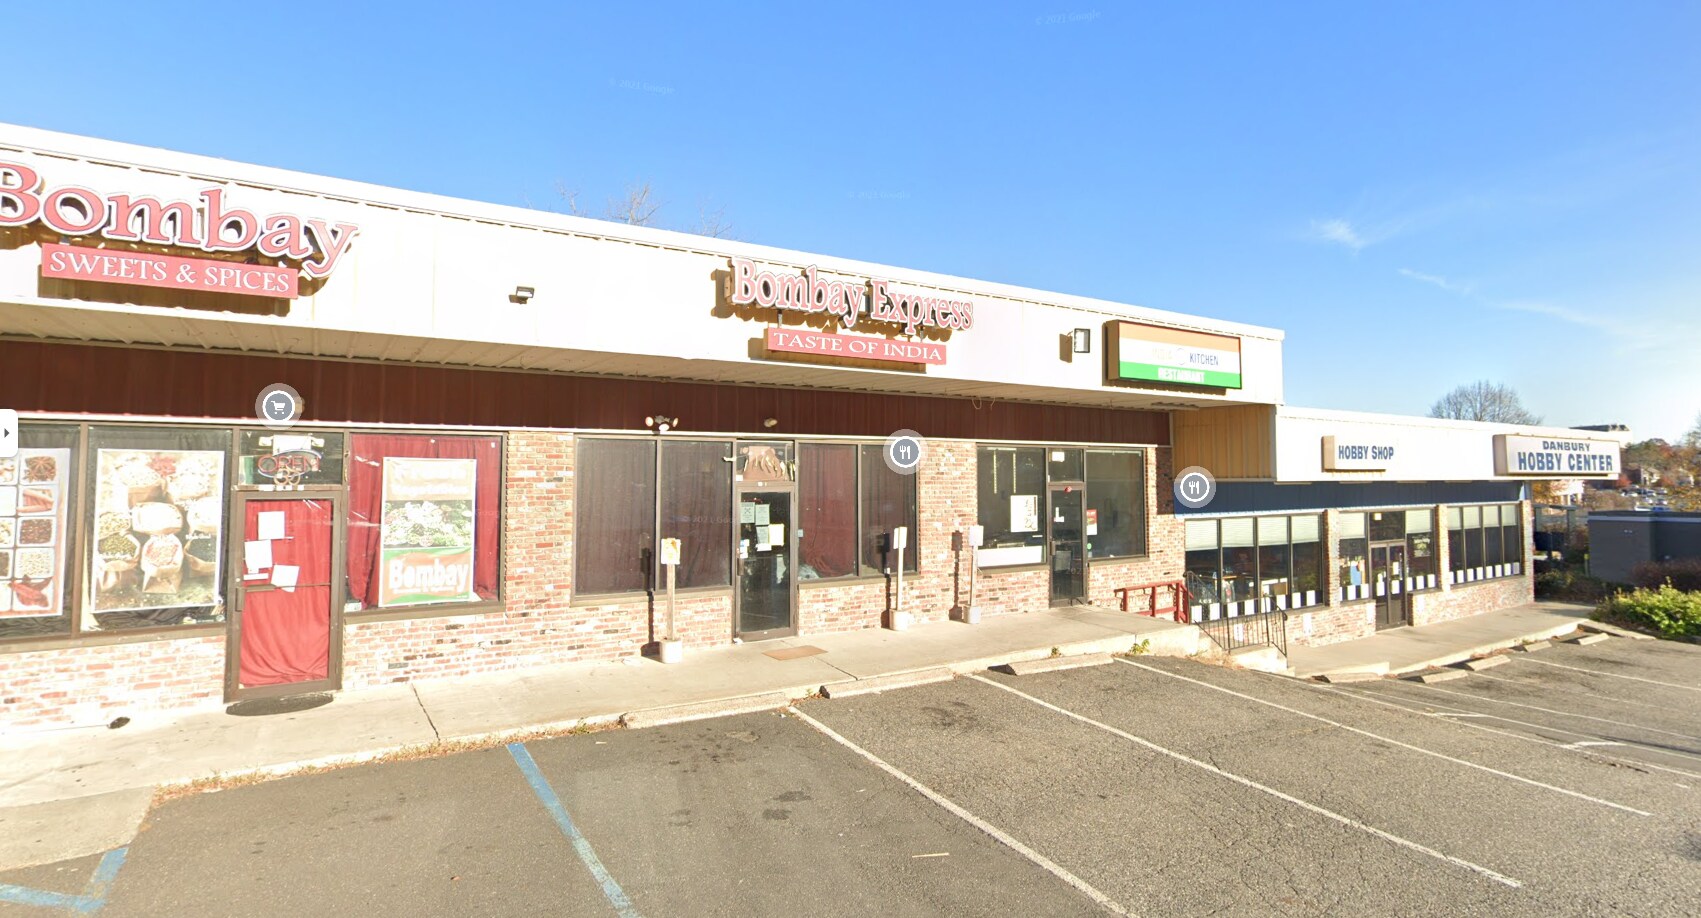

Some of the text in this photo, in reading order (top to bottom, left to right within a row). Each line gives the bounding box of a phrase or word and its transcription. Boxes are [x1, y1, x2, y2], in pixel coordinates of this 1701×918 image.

[0, 163, 358, 279] Bombay
[50, 251, 290, 292] SWEETS & SPICES
[732, 258, 974, 335] Bombay Express
[774, 332, 942, 361] TASTE OF INDIA
[1189, 352, 1219, 366] KITCHEN
[1338, 445, 1394, 460] HOBBY SHOP
[1542, 440, 1591, 452] DANBURY
[257, 453, 320, 474] OPEN
[1517, 452, 1613, 472] HOBBY CENTER
[388, 557, 469, 593] Bombay
